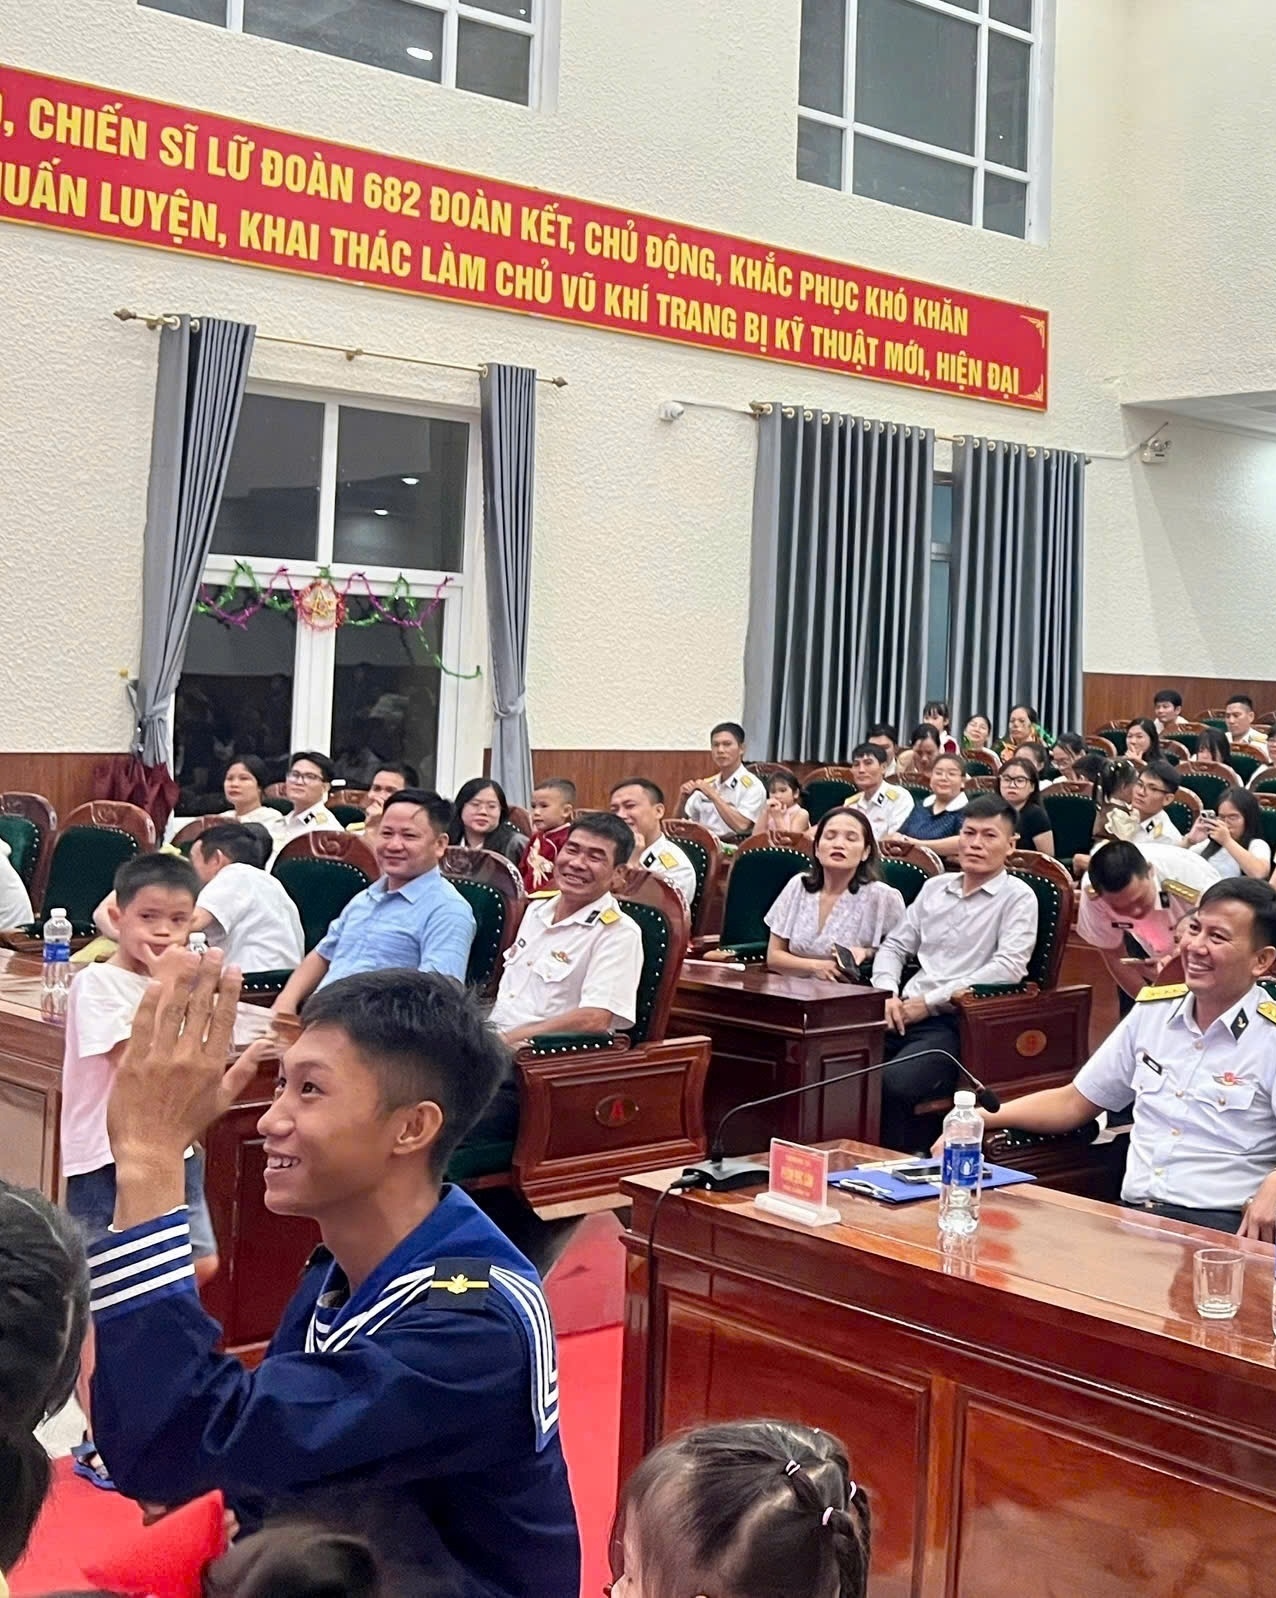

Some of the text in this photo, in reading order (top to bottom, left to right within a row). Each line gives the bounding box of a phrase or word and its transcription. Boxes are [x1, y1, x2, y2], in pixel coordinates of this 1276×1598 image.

[0, 157, 1020, 400] UẤN LUYỆN, KHAI THÁC LÀM CHỦ VŨ KHÍ TRANG BỊ KỸ THUẬT MỚI, HIỆN ĐẠI
[29, 97, 149, 160] CHIẾN
[159, 125, 197, 170] SĨ
[208, 134, 256, 182] LỮ
[261, 149, 354, 204] ĐOÀN
[364, 172, 421, 218] 682
[430, 185, 513, 237] ĐOÀN
[521, 201, 576, 255] KẾT,
[585, 218, 639, 264] CHỦ
[645, 233, 723, 285] ĐỘNG,
[730, 251, 794, 299] KHẮC
[800, 270, 860, 316] PHỤC
[865, 285, 908, 323] KHÓ
[913, 296, 969, 337] KHĂN
